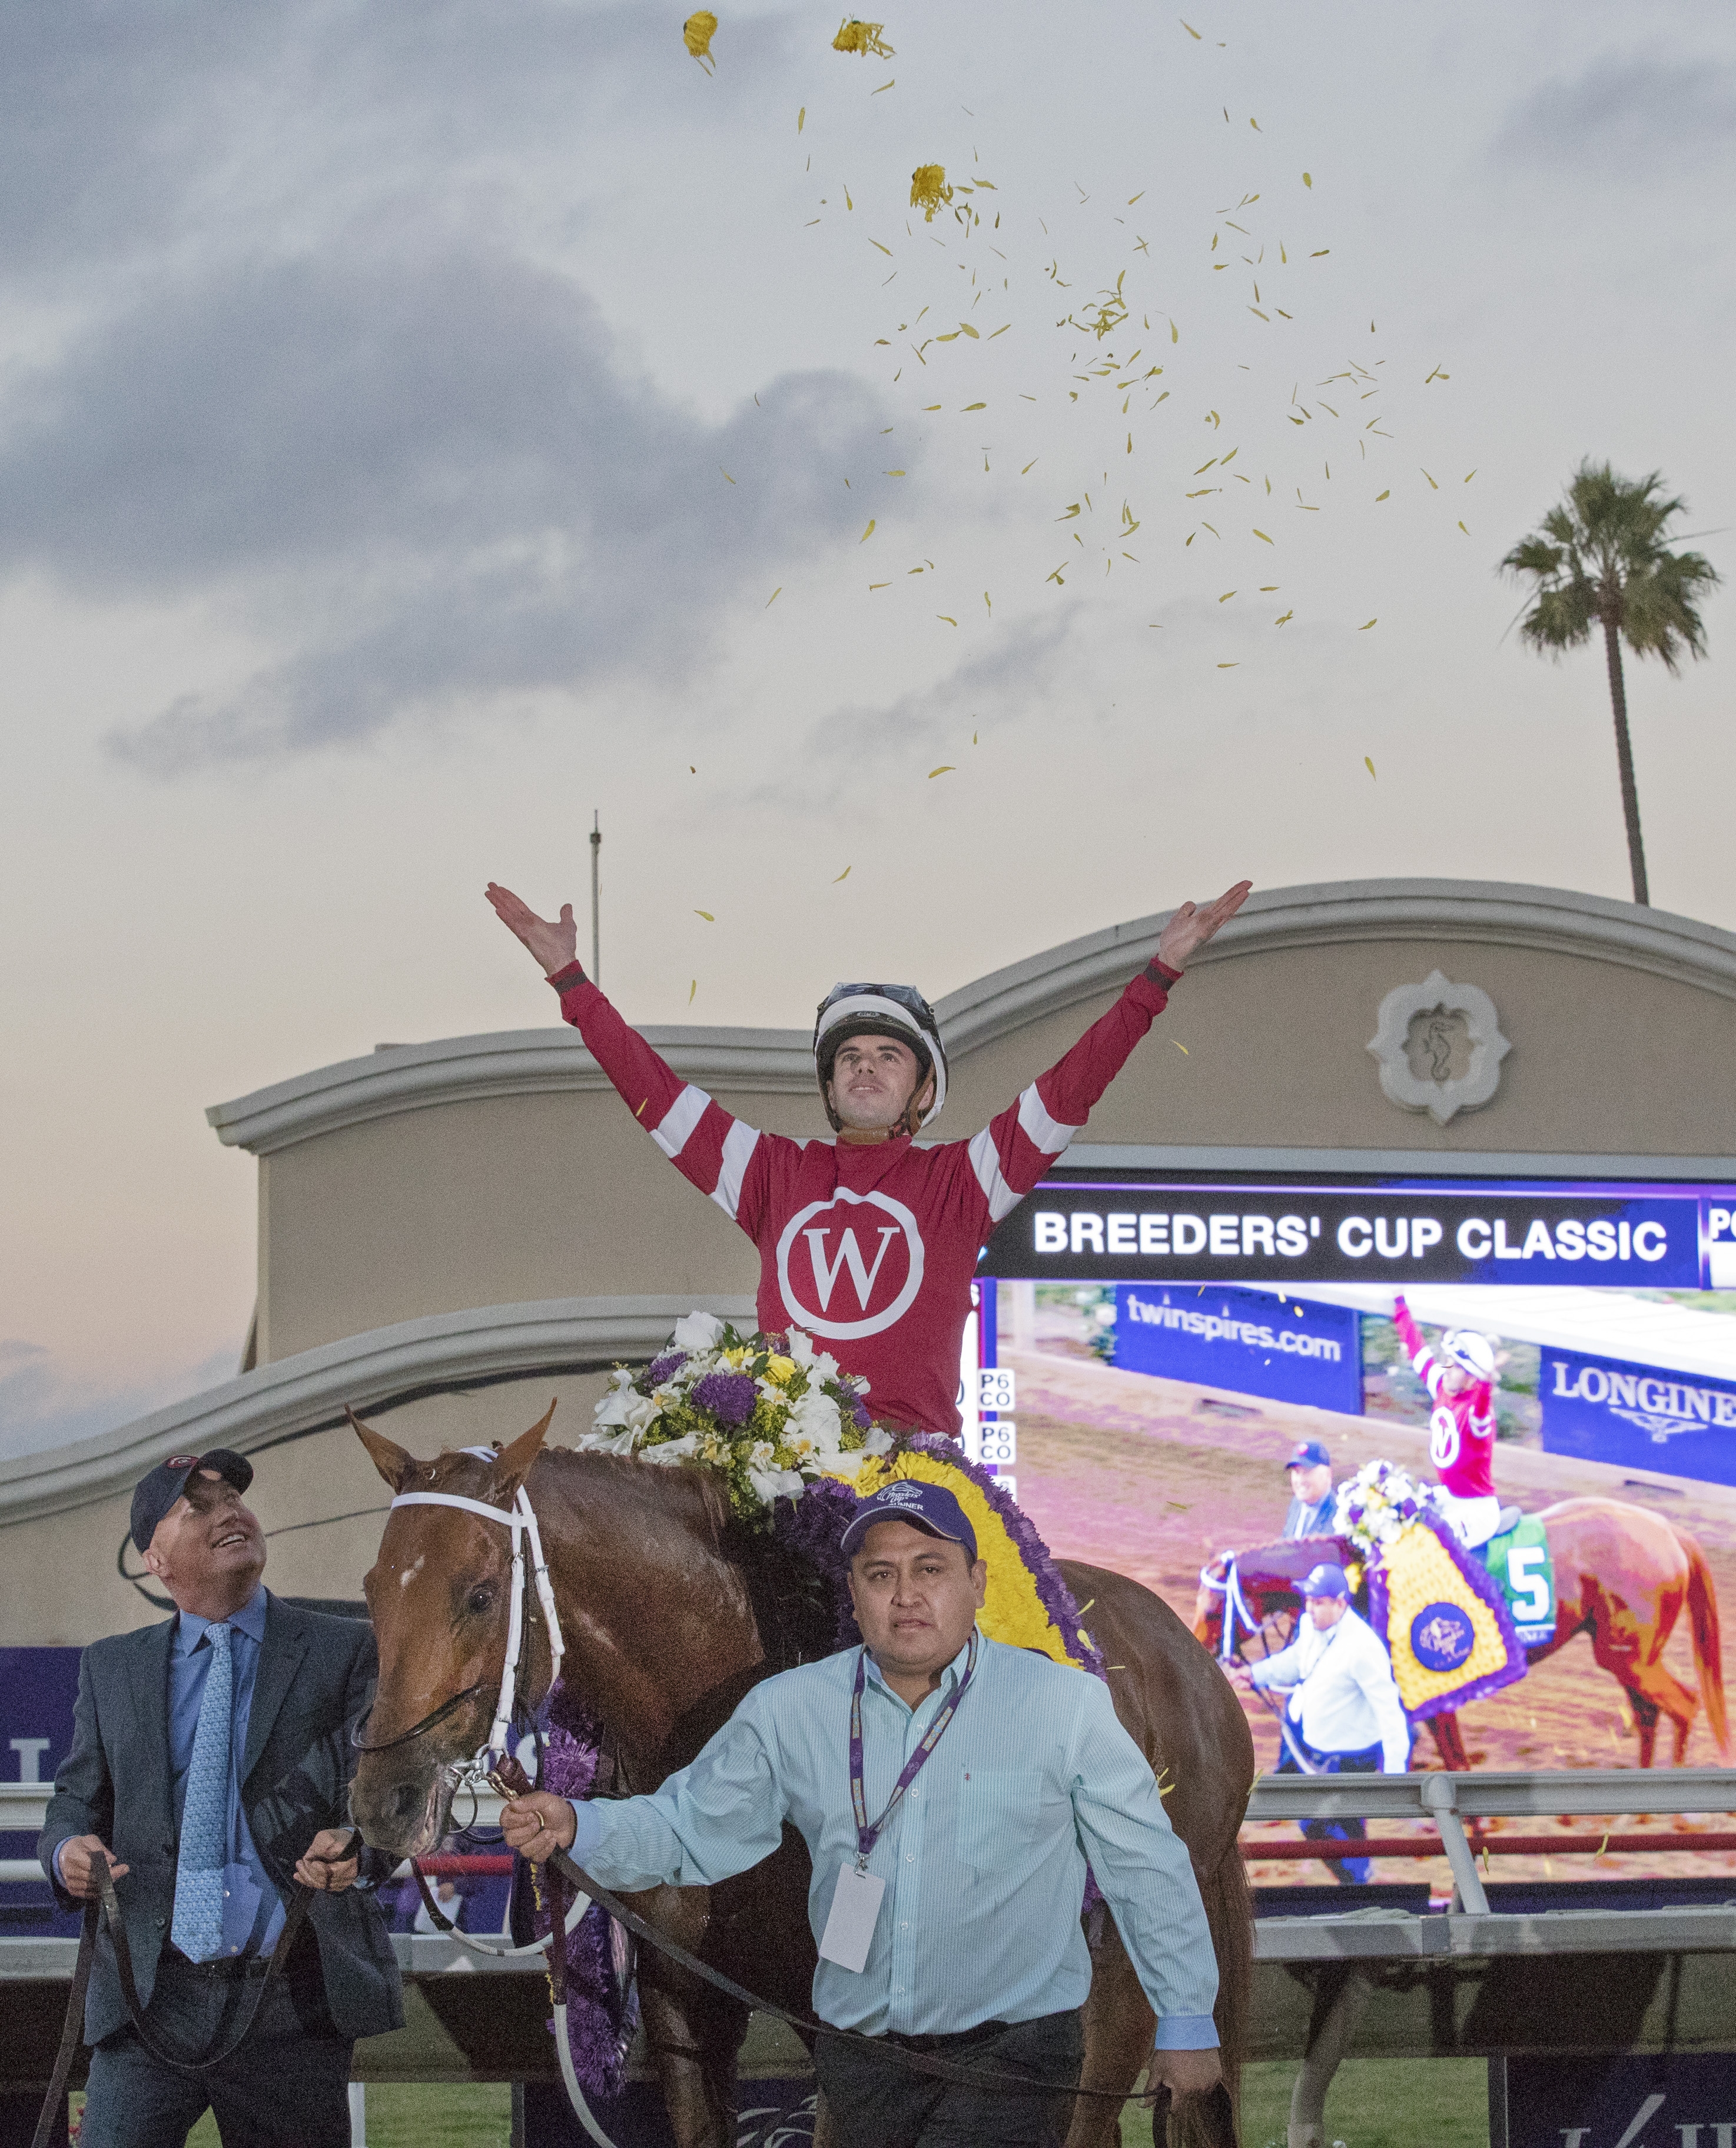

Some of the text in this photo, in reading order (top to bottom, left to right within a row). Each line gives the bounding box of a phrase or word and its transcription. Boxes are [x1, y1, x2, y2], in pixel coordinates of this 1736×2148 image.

[1033, 1212, 1668, 1262] BREEDERS' CUP CLASSIC
[802, 1227, 901, 1312] W
[1127, 1294, 1342, 1362] twinspires.com
[980, 1392, 1010, 1406] CO
[981, 1374, 1009, 1388] P6
[1551, 1361, 1736, 1428] LONGINE
[980, 1445, 1011, 1459] CO
[982, 1427, 1010, 1442] P6
[1507, 1546, 1550, 1621] 5
